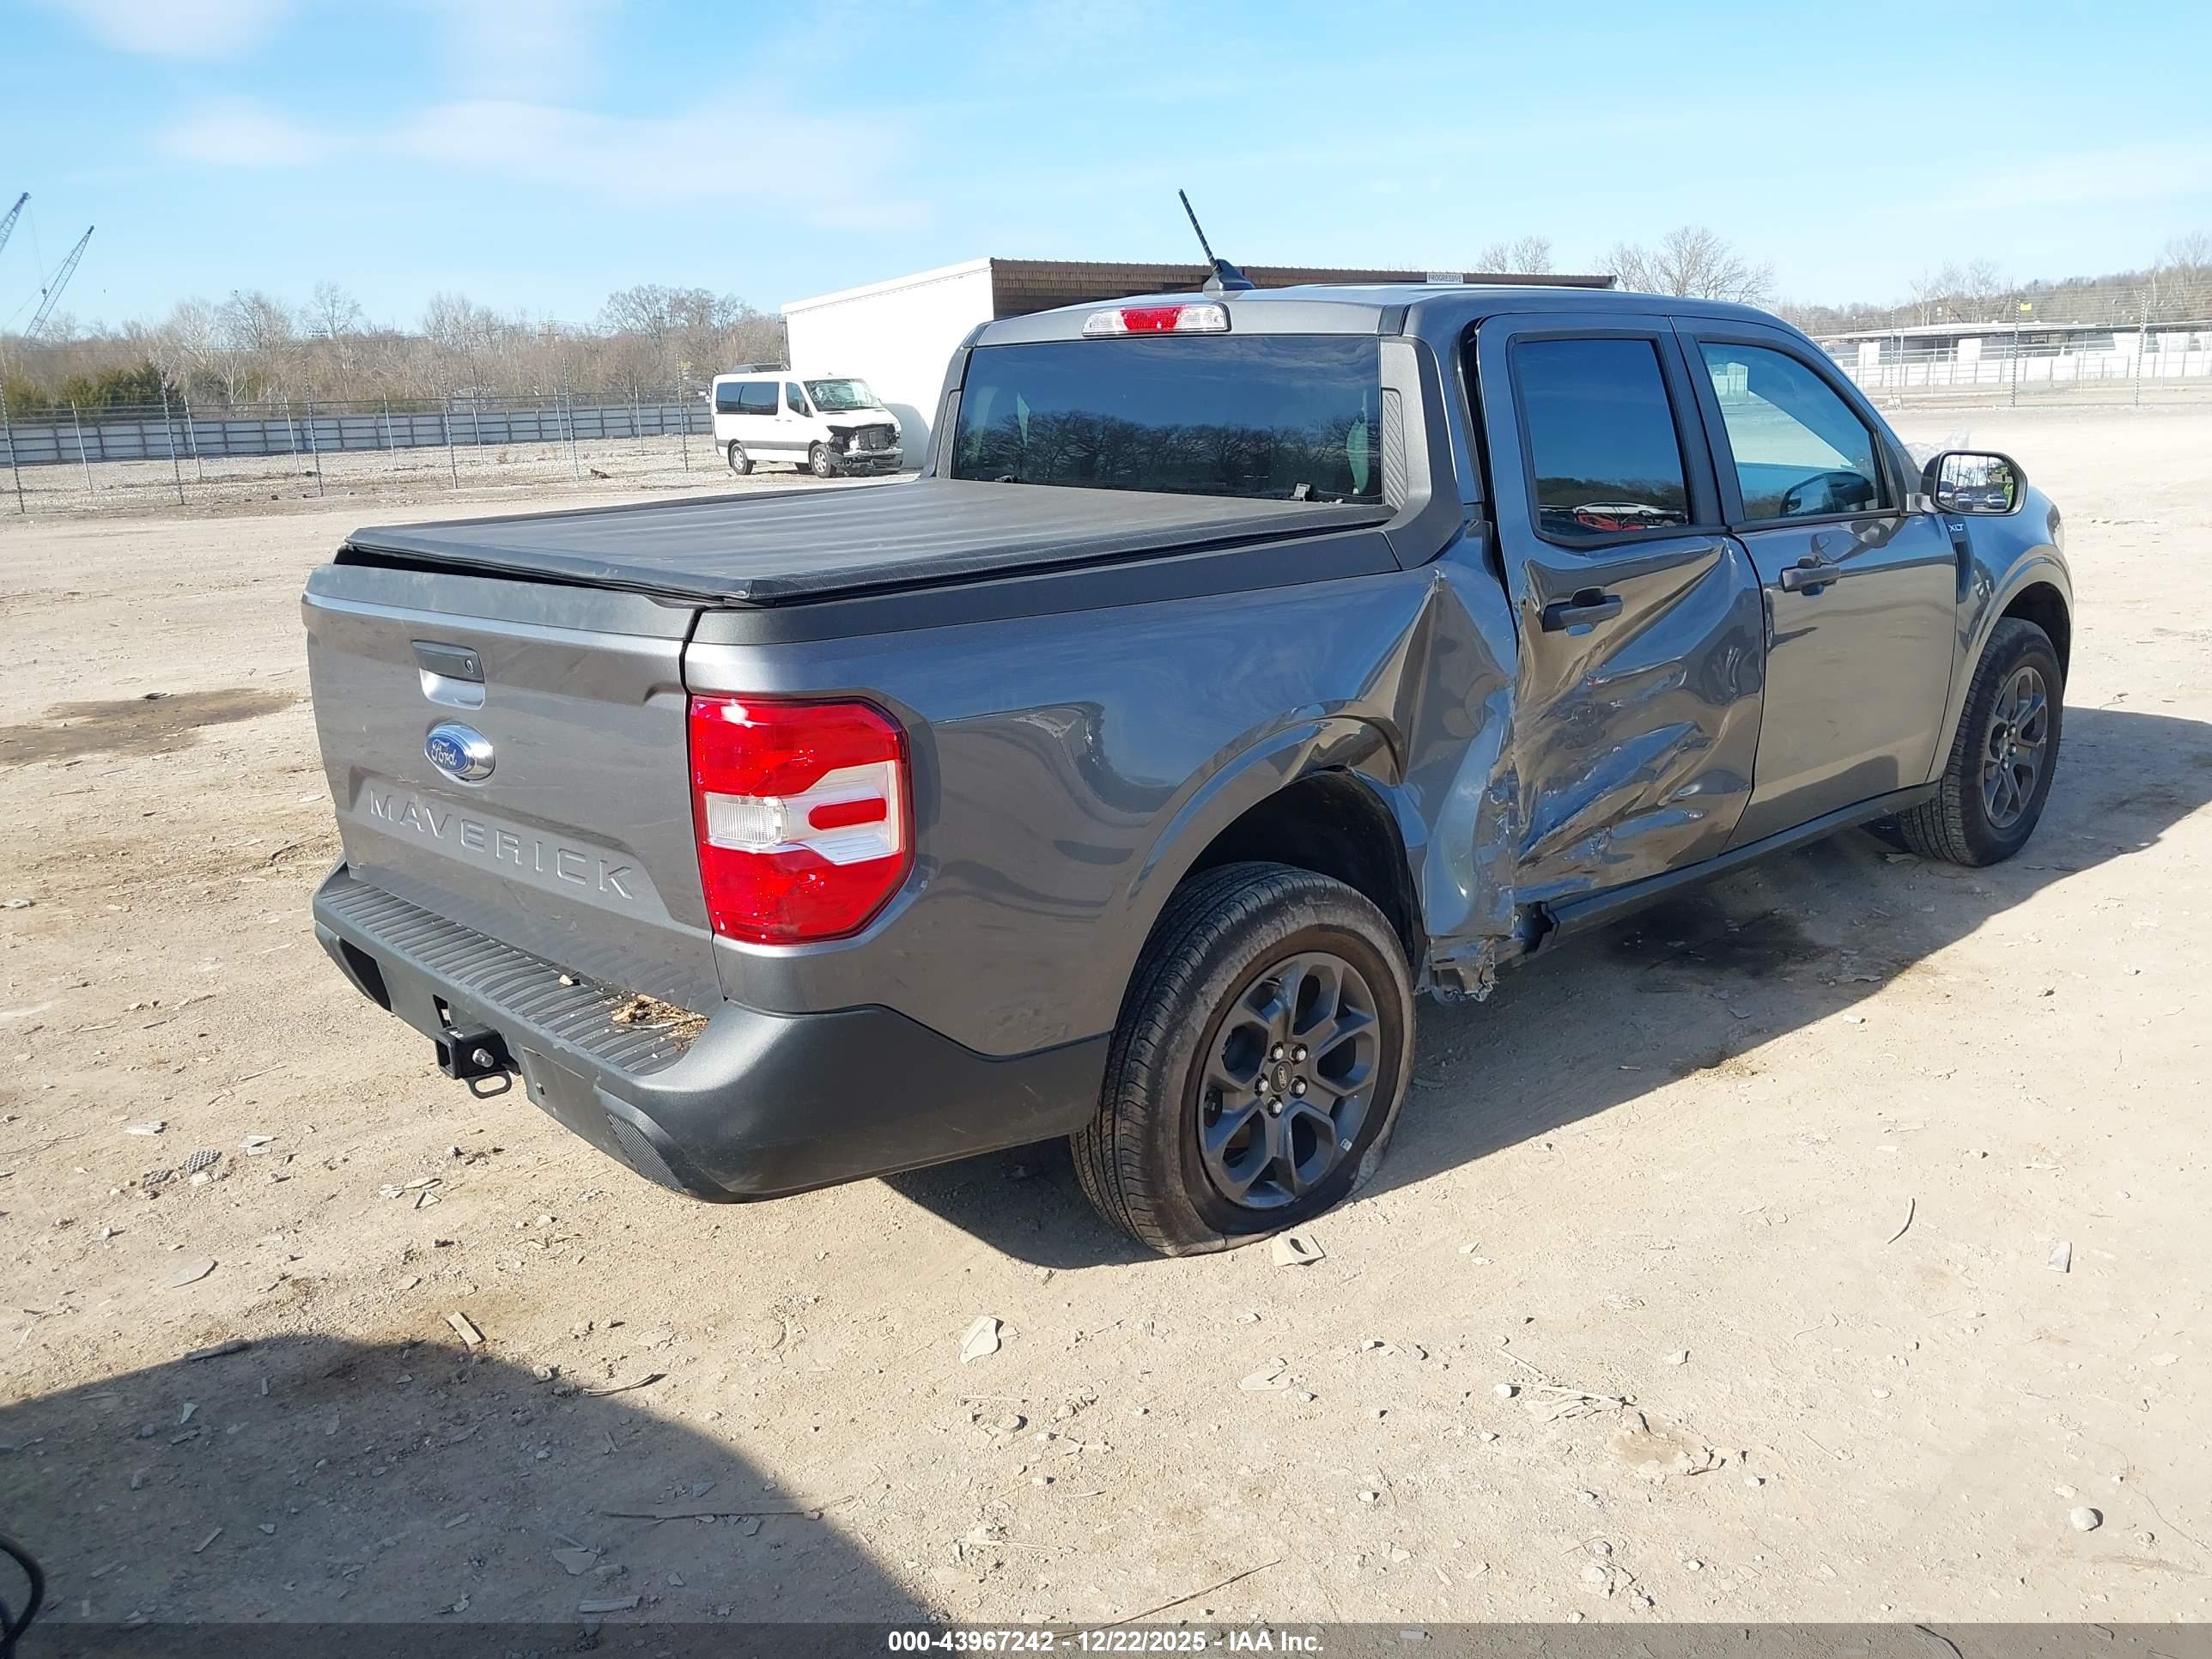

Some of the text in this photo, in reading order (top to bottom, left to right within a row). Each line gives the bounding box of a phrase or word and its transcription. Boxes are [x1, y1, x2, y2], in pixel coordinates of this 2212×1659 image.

[1428, 274, 1462, 283] PROGRESSIVE
[1948, 523, 1965, 532] XLT
[431, 738, 458, 766] Ford
[369, 788, 634, 900] MAVERICK
